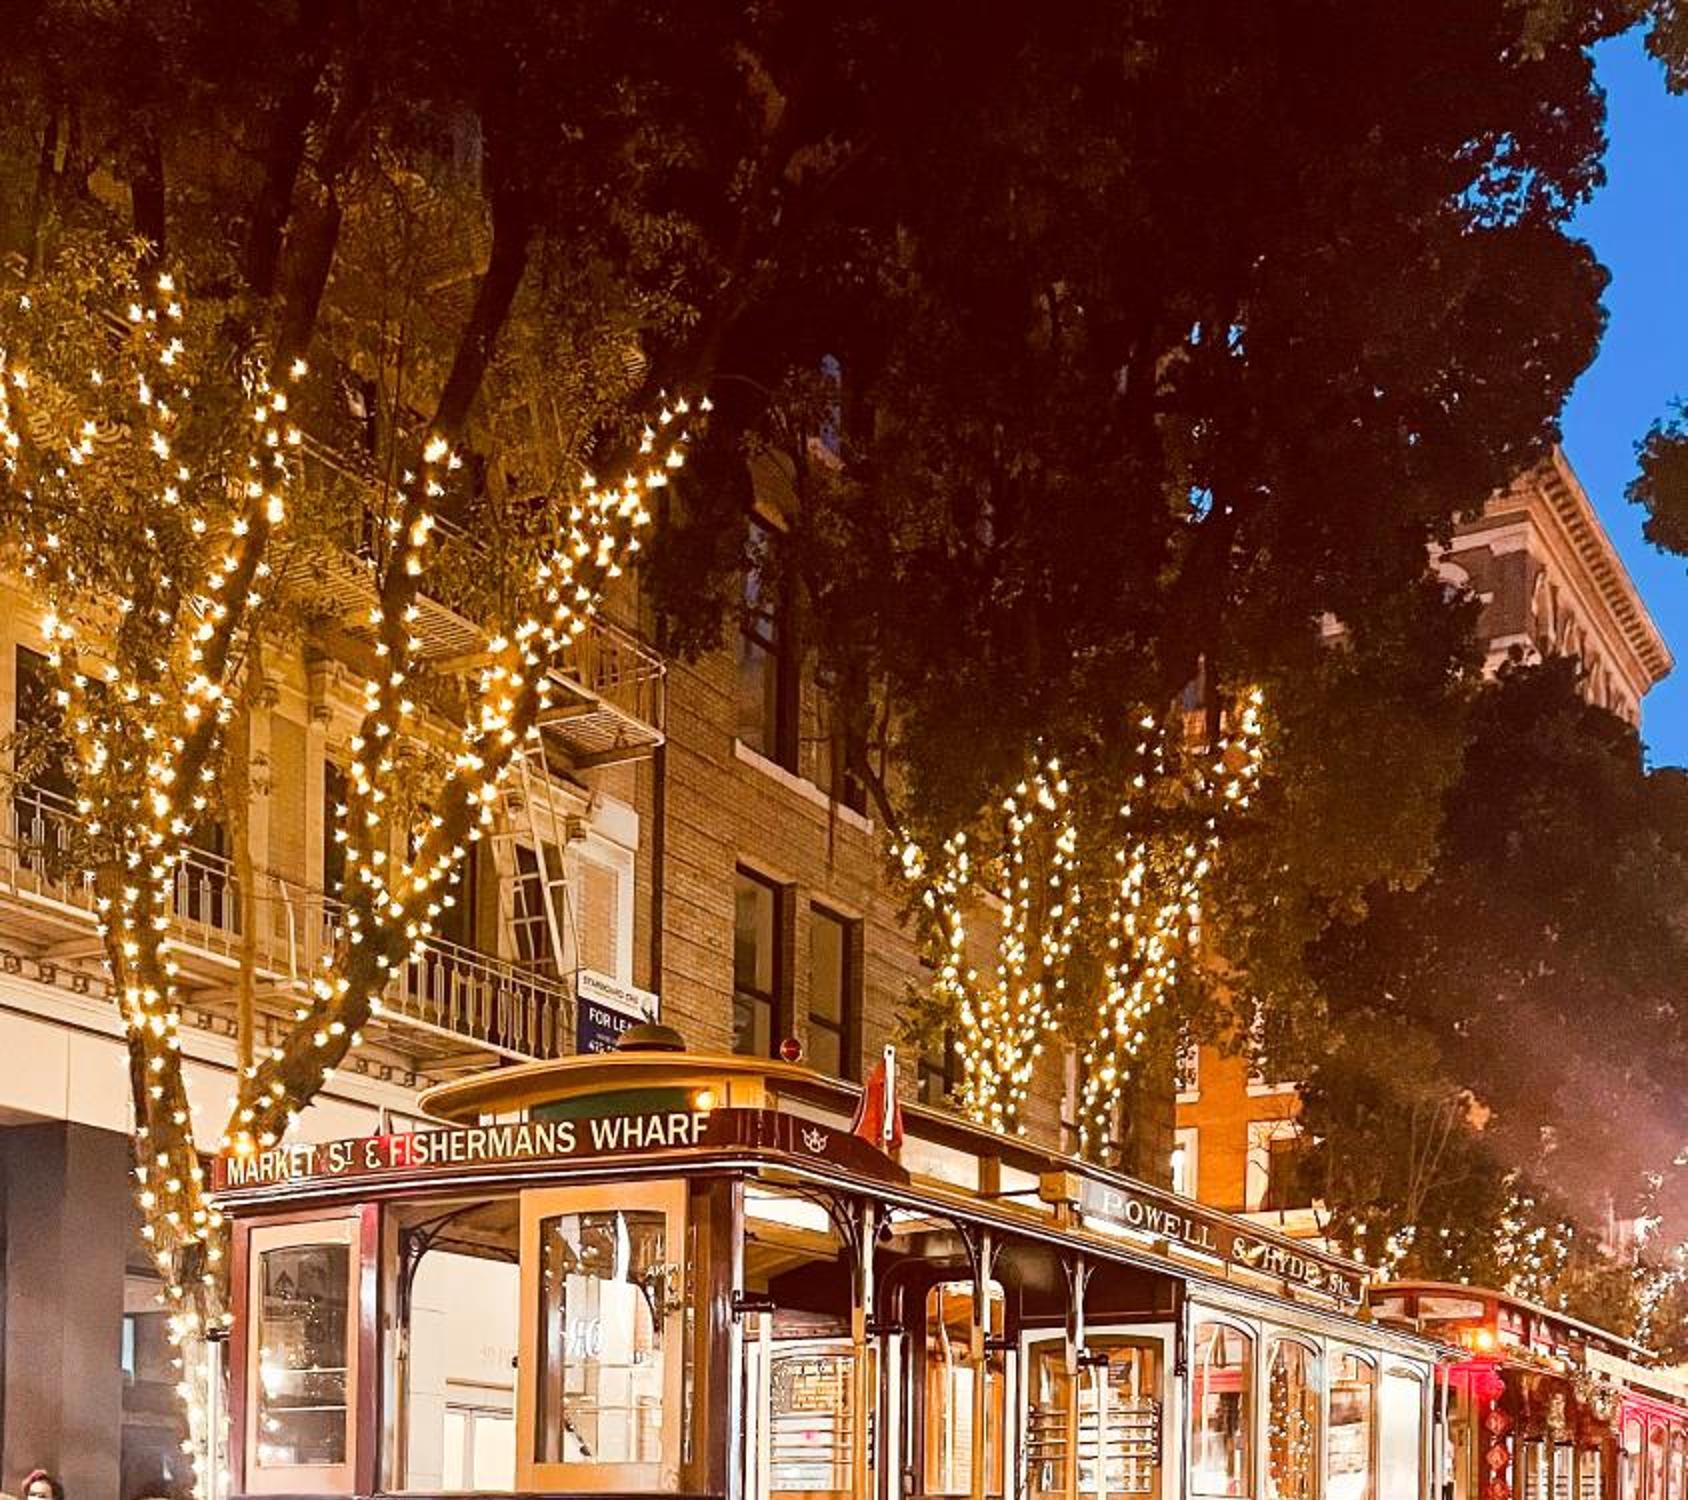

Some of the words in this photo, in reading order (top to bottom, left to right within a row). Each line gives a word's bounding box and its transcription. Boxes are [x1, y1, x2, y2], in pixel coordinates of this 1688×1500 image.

[588, 1006, 611, 1029] FOR
[227, 1144, 317, 1186] MARKET
[329, 1141, 355, 1173] ST
[365, 1139, 382, 1169] &
[389, 1121, 576, 1167] FISHERMANS
[590, 1111, 711, 1151] WHARF
[1102, 1190, 1217, 1251] POWELL
[1231, 1237, 1248, 1261] &
[1262, 1243, 1324, 1288] HYDE
